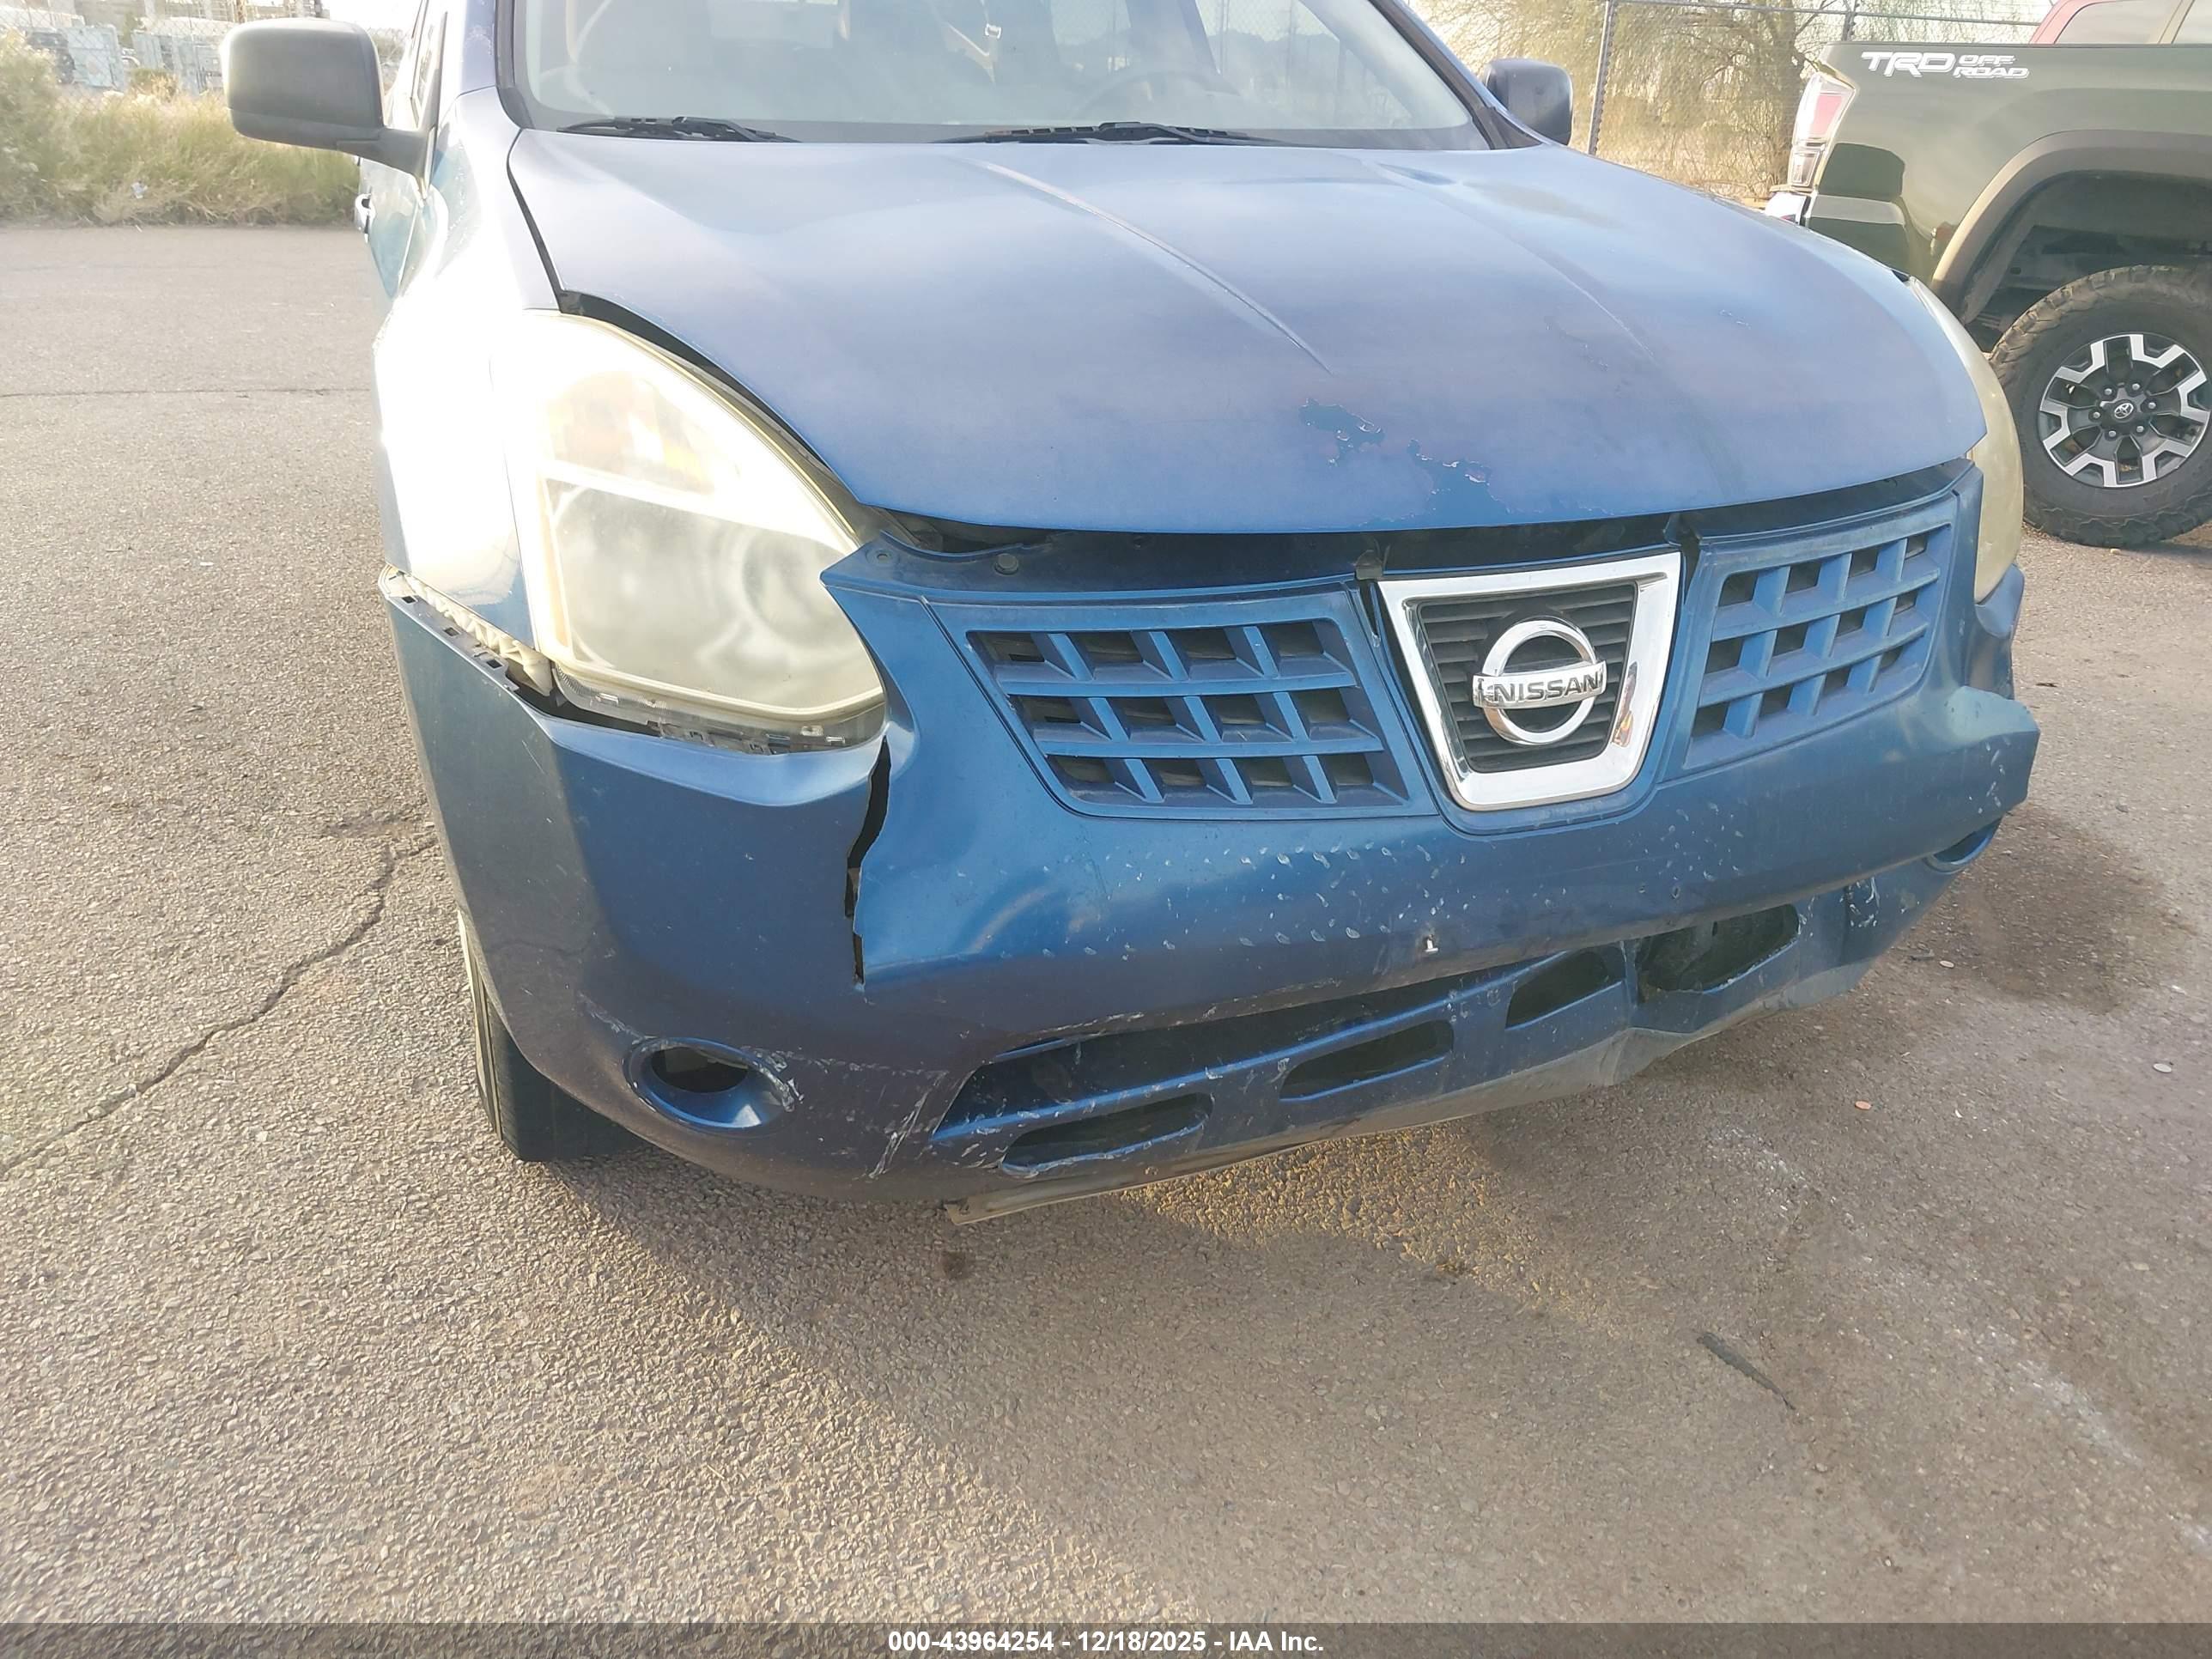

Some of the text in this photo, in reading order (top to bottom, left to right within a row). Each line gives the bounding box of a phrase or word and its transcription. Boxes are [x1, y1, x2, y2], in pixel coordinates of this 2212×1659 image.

[1861, 51, 2016, 77] TRD OFF
[1953, 66, 2031, 79] ROAD
[1492, 670, 1603, 703] NISSAN
